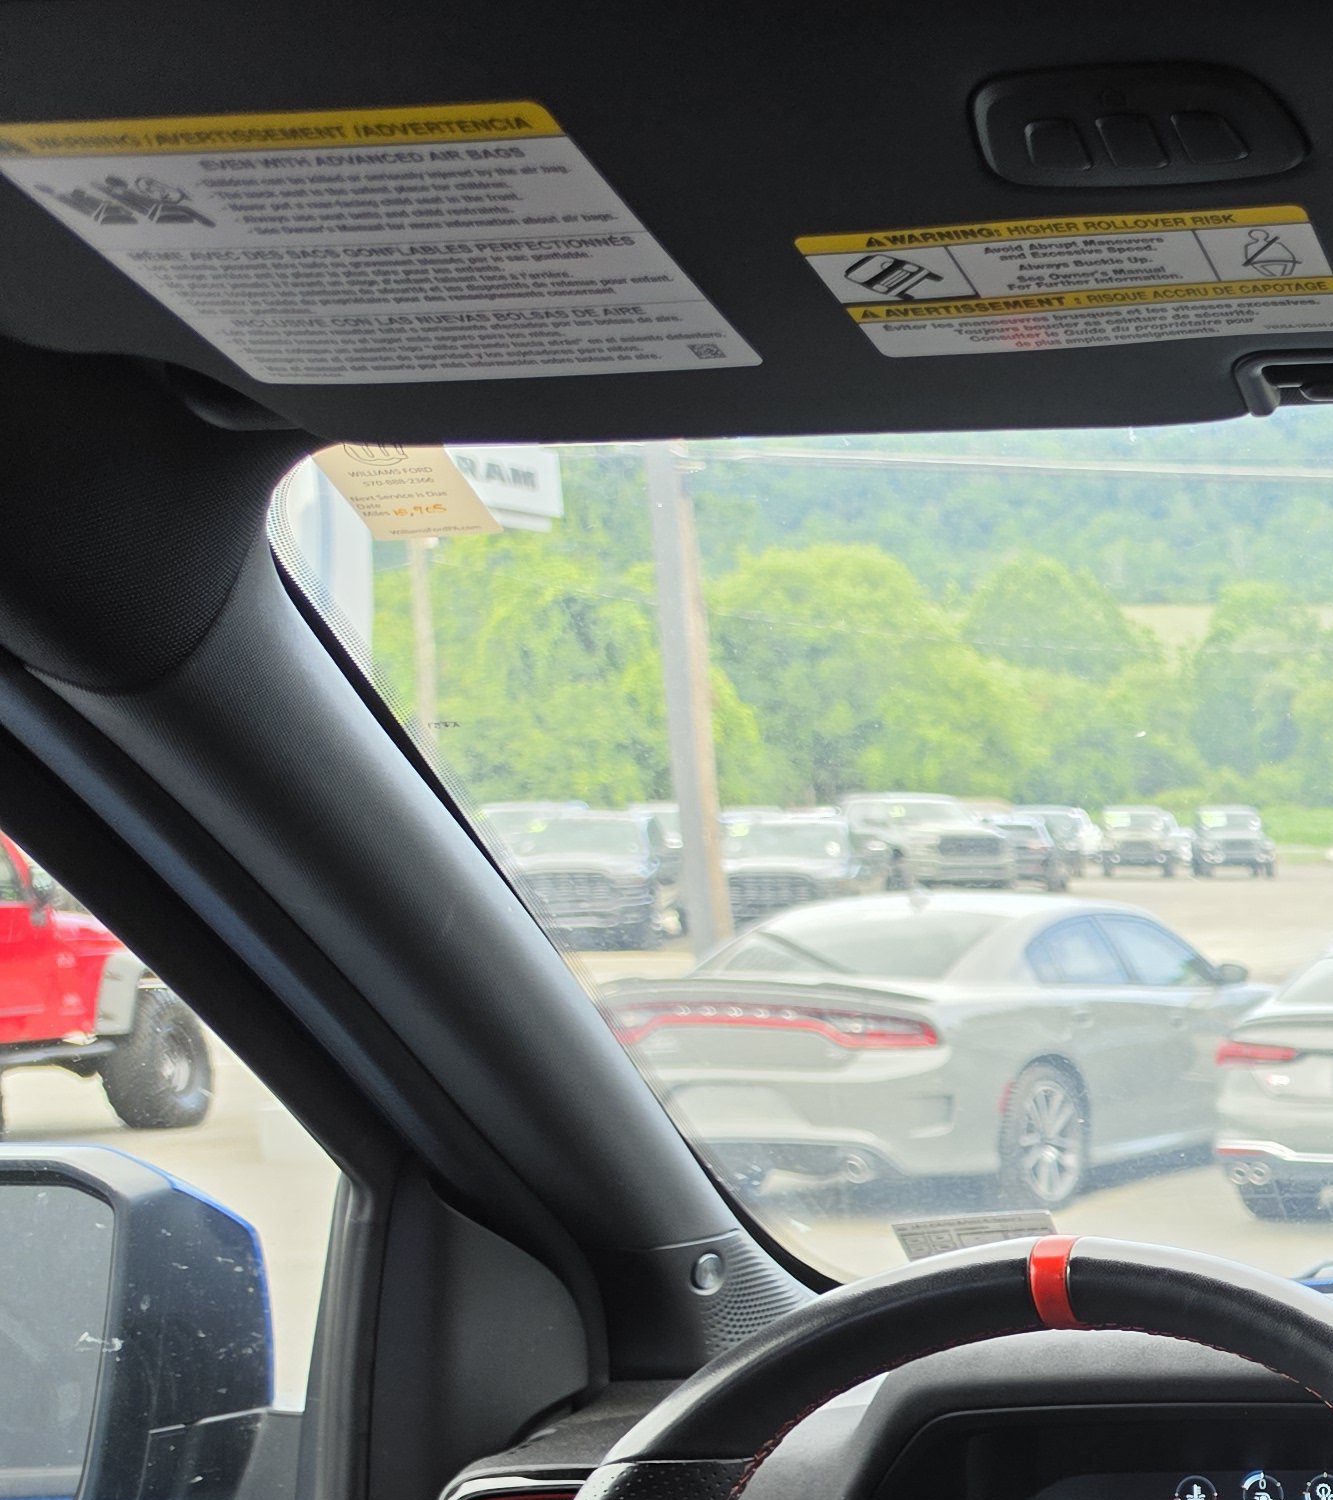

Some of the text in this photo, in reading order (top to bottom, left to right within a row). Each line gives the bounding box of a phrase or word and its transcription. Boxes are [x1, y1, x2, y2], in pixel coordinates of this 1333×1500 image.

[314, 151, 424, 167] ADVANCED
[429, 149, 464, 162] AIR
[470, 147, 526, 160] BAGS
[1006, 221, 1083, 236] HIGHER
[1086, 216, 1187, 232] ROLLOVER
[1191, 213, 1239, 227] RISK
[478, 235, 636, 254] PERFECTIONNÉS
[984, 243, 1023, 256] Avoid
[1028, 240, 1080, 254] Abrupt
[999, 252, 1027, 262] and
[1108, 244, 1158, 256] Speed.
[1018, 254, 1154, 273] Always Buckle Up.
[1112, 265, 1167, 278] Manual
[884, 296, 1067, 320] AVERTISSEMENT
[1087, 290, 1148, 304] RISQUE
[1153, 286, 1207, 300] ACCRU
[1213, 284, 1237, 296] DE
[1238, 280, 1329, 296] CAPOTAGE
[331, 317, 372, 328] CON
[418, 312, 492, 326] NUEVAS
[494, 309, 570, 323] BOLSAS
[573, 308, 598, 320] DE
[603, 305, 645, 318] AIRE
[348, 465, 433, 479] WILLIAMS FORD
[455, 454, 540, 492] RAM
[350, 494, 376, 504] Next
[377, 492, 413, 502] Service
[425, 489, 449, 499] Due
[355, 501, 381, 511] Date
